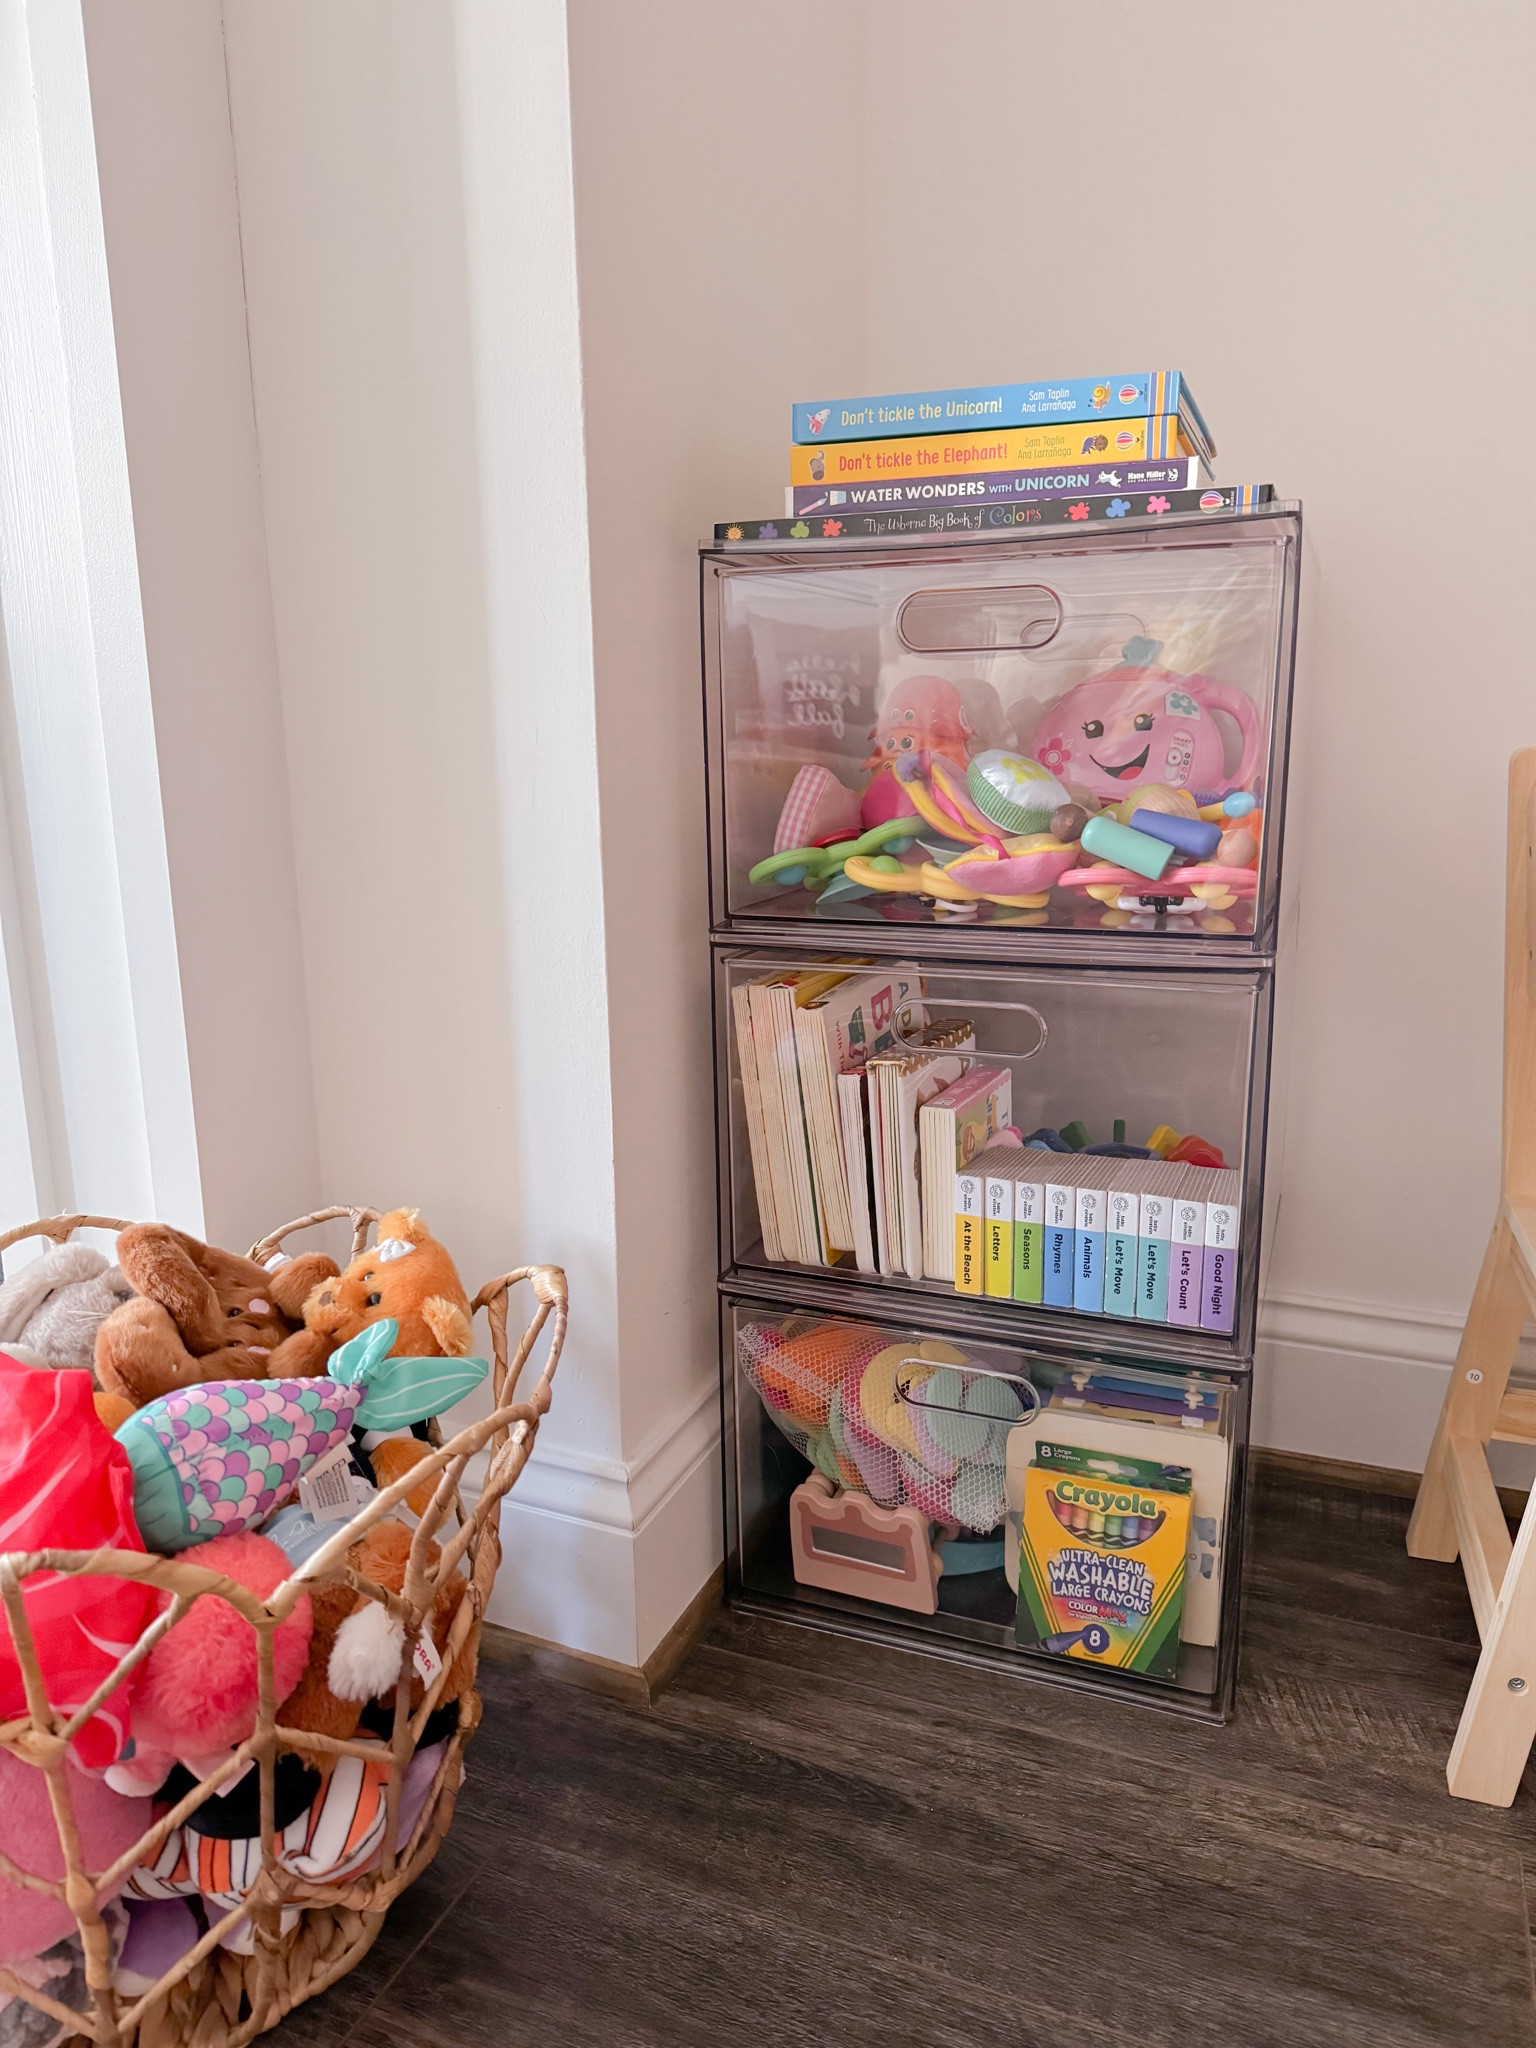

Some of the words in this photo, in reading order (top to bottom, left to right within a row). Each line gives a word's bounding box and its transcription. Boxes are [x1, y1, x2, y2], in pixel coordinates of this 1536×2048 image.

[1021, 403, 1036, 413] Ana
[1038, 400, 1076, 412] Larrañaga
[1029, 390, 1045, 401] Sam
[1047, 388, 1070, 401] Taplin
[841, 407, 874, 426] Don't
[878, 405, 915, 423] tickle
[919, 403, 942, 419] the
[946, 397, 1003, 417] Unicorn!
[1017, 450, 1032, 460] Ana
[1034, 446, 1072, 459] Larrañaga
[1024, 437, 1041, 448] Sam
[1043, 435, 1065, 447] Taplin
[839, 453, 872, 472] Don't
[875, 451, 912, 469] tickle
[917, 450, 939, 465] the
[943, 443, 1008, 465] Elephant!
[851, 487, 902, 504] WATER
[905, 481, 986, 500] WONDERS
[989, 484, 1012, 494] WITH
[1015, 473, 1090, 492] UNICORN
[1127, 472, 1145, 480] Kane
[1146, 470, 1166, 479] Miller
[863, 518, 885, 535] The
[887, 514, 926, 531] Usborne
[928, 513, 945, 533] Big
[946, 512, 973, 529] Book
[974, 508, 985, 529] of
[989, 505, 1042, 526] Colors
[963, 1220, 972, 1233] At
[963, 1234, 972, 1252] the
[992, 1225, 1001, 1262] Letters
[1023, 1228, 1032, 1270] Seasons
[1053, 1233, 1063, 1275] Rhymes
[1115, 1239, 1125, 1265] Let's
[1147, 1244, 1157, 1270] Let's
[963, 1254, 972, 1285] Beach
[1083, 1236, 1093, 1279] Animals
[1180, 1250, 1191, 1276] Let's
[1214, 1254, 1224, 1283] Good
[1113, 1267, 1123, 1295] Move
[1146, 1272, 1156, 1300] Move
[1178, 1278, 1190, 1310] Count
[1211, 1285, 1223, 1316] Night
[1469, 1372, 1480, 1382] 10
[1040, 1445, 1052, 1458] 8
[1053, 1446, 1072, 1457] Large
[1053, 1452, 1081, 1463] Crayons
[1055, 1480, 1158, 1517] Crayola
[1061, 1549, 1145, 1576] ULTRA-CLEAN
[1048, 1562, 1153, 1601] WASHABLE
[1052, 1581, 1091, 1598] LARGE
[1094, 1587, 1151, 1615] CRAYONS
[1089, 1630, 1101, 1647] 8
